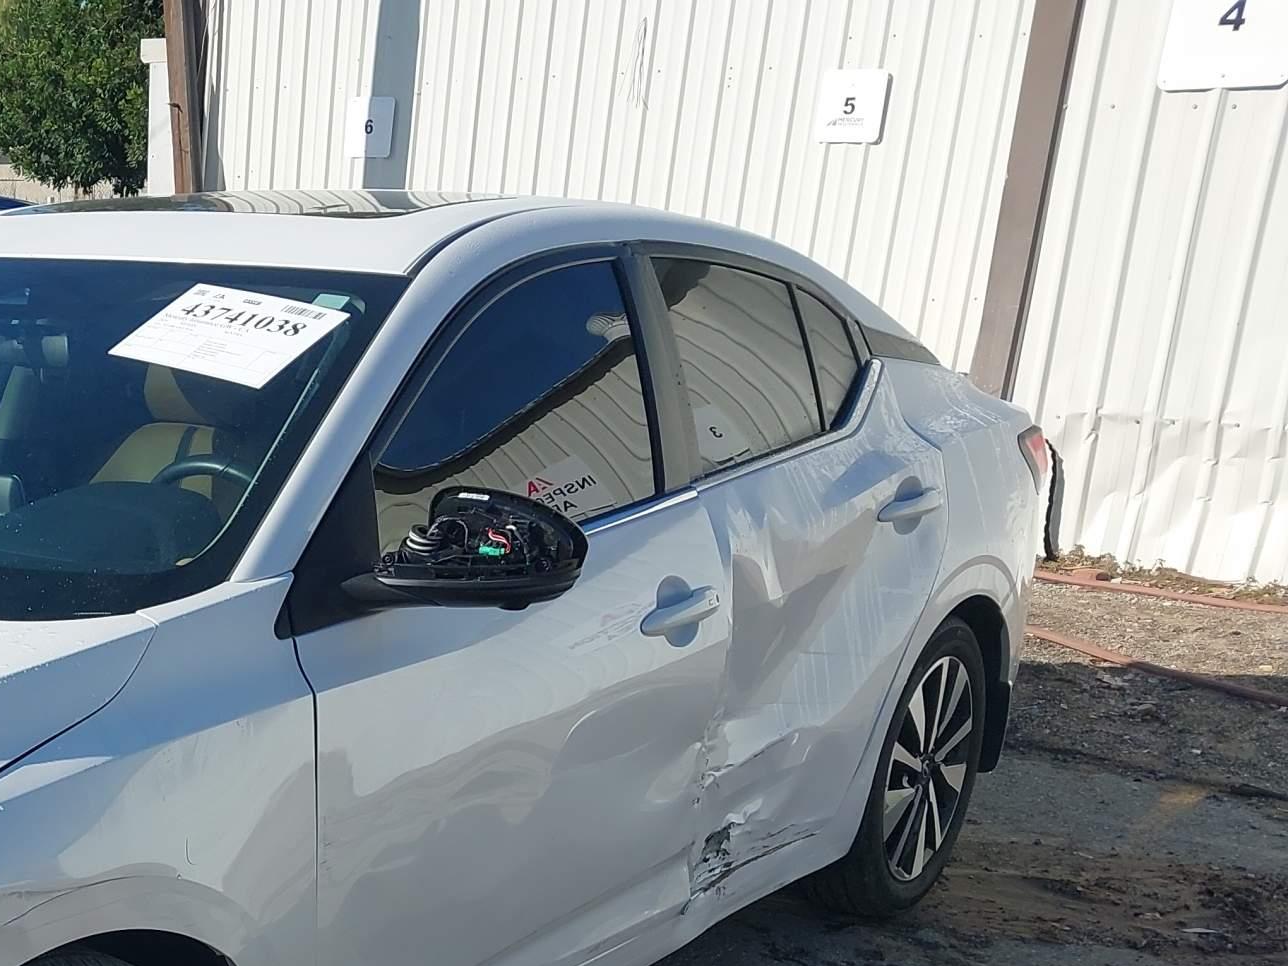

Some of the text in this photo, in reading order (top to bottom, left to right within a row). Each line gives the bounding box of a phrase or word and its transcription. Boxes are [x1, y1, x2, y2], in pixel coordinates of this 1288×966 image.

[1218, 0, 1248, 31] 4
[843, 96, 856, 115] 5
[364, 118, 374, 135] 6
[180, 302, 308, 337] 43741038
